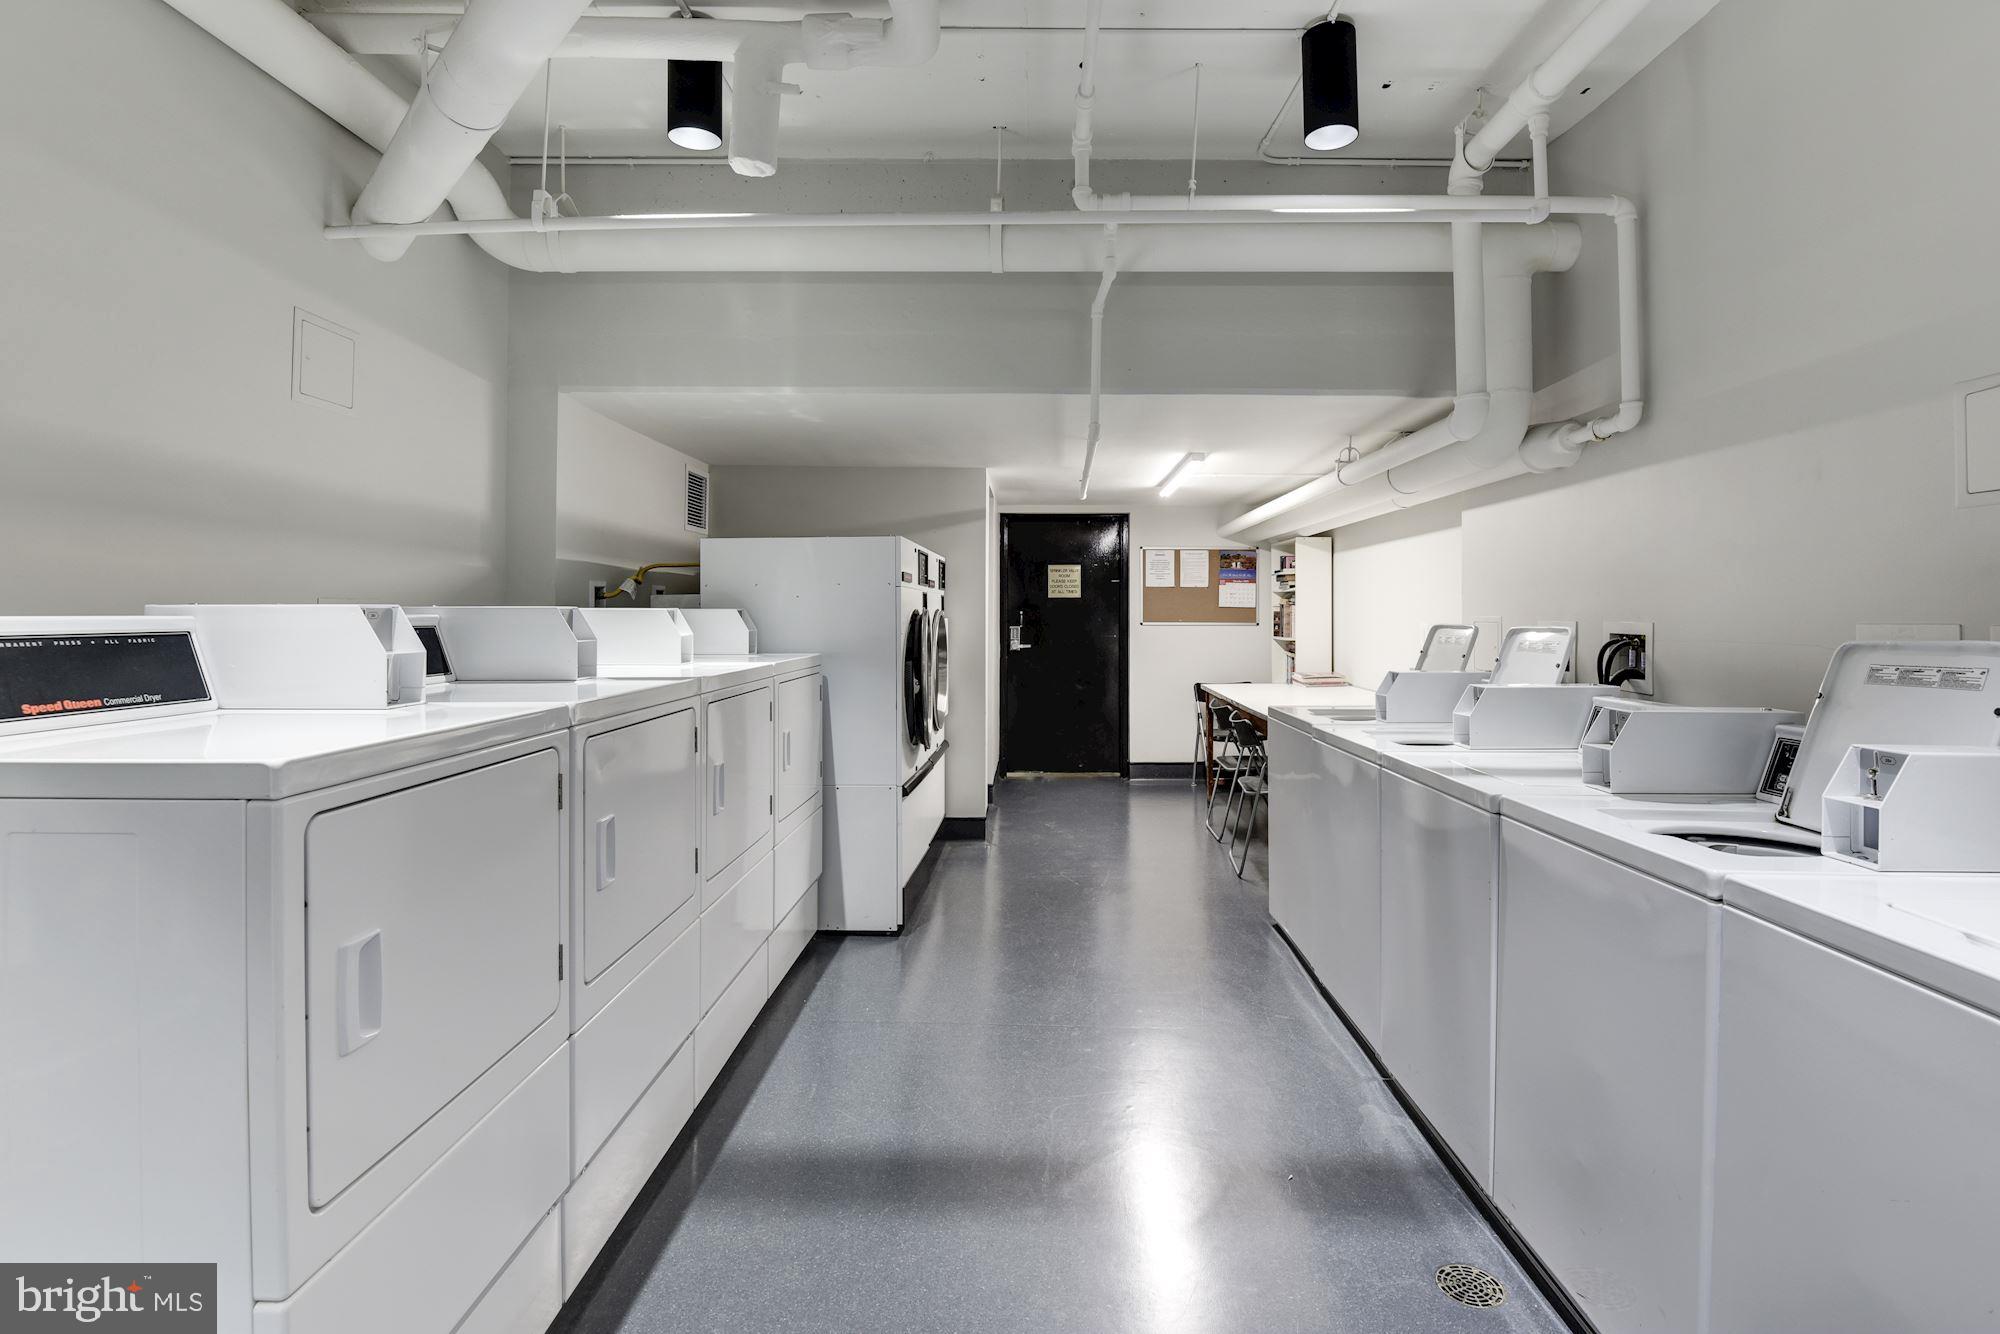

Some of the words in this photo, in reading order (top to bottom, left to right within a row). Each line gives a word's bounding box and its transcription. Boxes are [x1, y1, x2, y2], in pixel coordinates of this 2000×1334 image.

[21, 701, 63, 716] Speed
[63, 698, 103, 710] Queen
[103, 694, 143, 706] Commercial
[144, 693, 162, 703] Dryer
